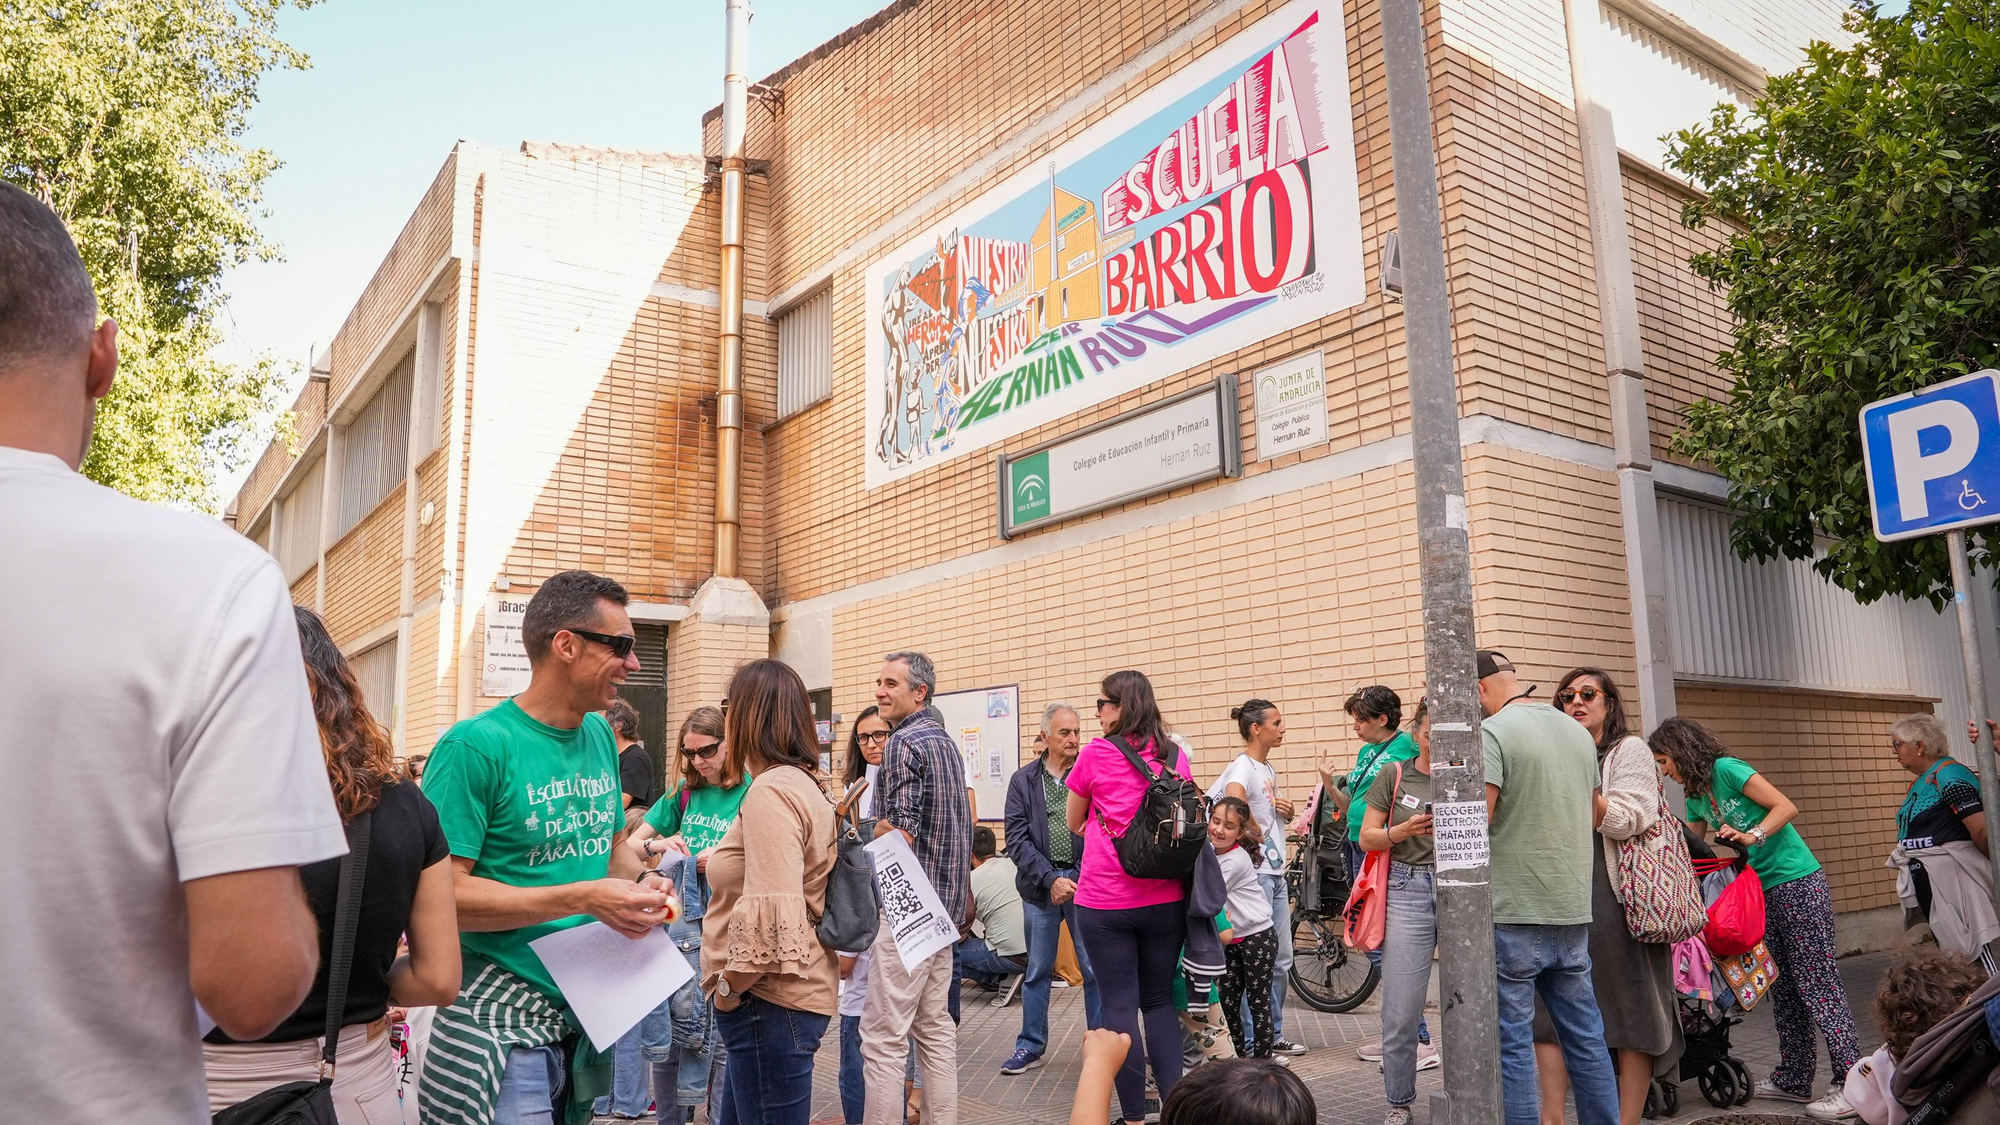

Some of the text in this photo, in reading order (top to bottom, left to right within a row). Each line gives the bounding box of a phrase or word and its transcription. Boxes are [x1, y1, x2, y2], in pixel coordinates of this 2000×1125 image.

[958, 42, 1310, 310] NUESTRA ESCUELA
[958, 167, 1312, 396] NUESTRO BARRIO
[1279, 367, 1316, 389] JUNTA DE
[1271, 420, 1290, 431] Colegio
[1297, 425, 1311, 438] Ruiz
[1073, 417, 1210, 471] Colegio de Educación Infantil y Primaria
[1160, 441, 1212, 468] Hernán Ruiz
[1887, 399, 1980, 522] P
[527, 777, 581, 806] ESCUELA
[545, 818, 566, 838] DE
[1437, 829, 1483, 840] CHATARRA
[1437, 842, 1472, 851] DESALOJO
[1474, 841, 1482, 849] DE
[1899, 836, 1933, 849] CEITE
[524, 842, 577, 867] PARA
[1937, 1080, 1954, 1100] AVUS
